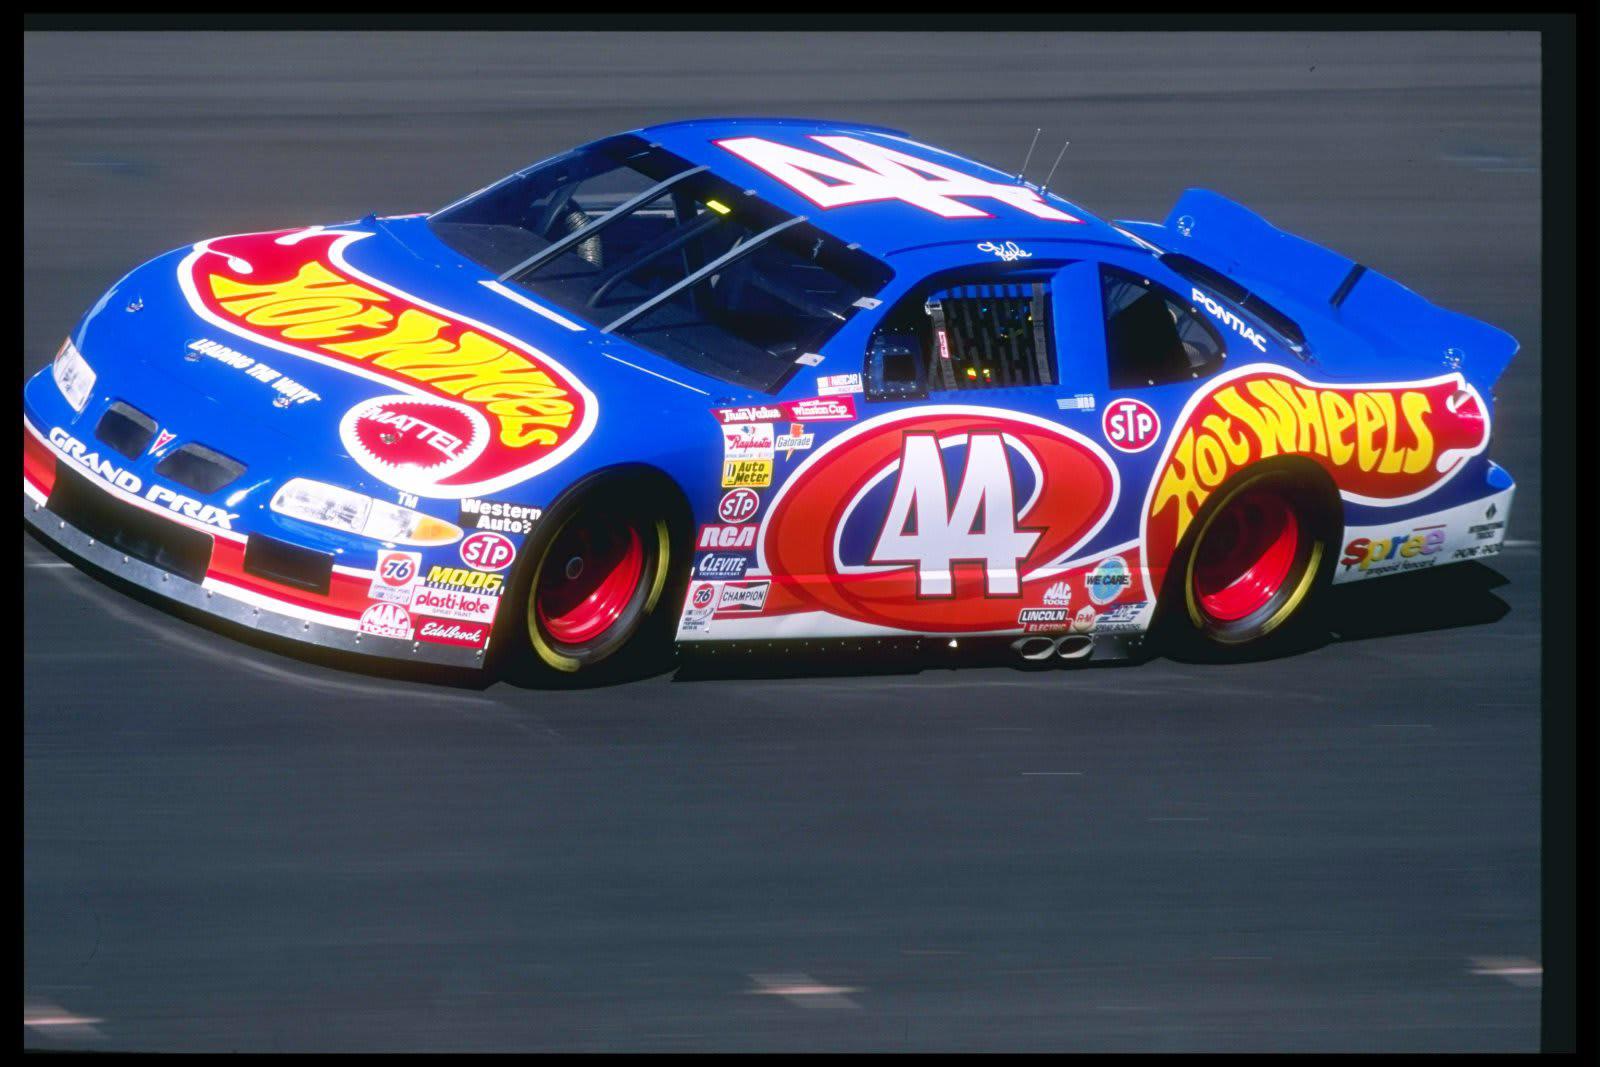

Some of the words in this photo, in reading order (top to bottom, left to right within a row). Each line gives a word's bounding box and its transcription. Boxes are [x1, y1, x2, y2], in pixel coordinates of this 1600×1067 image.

[712, 135, 1087, 224] 44
[1191, 287, 1267, 353] PONTIAC
[245, 363, 282, 383] THE
[746, 406, 782, 422] Value
[828, 404, 848, 417] Cup
[366, 406, 467, 461] MATTEL
[1110, 404, 1153, 443] STP
[777, 436, 811, 448] Gatorade
[738, 462, 765, 473] Auto
[49, 427, 142, 492] GRAND
[145, 484, 241, 531] PRIX
[735, 472, 769, 484] Meter
[398, 491, 419, 509] TM
[460, 498, 542, 520] Western
[722, 491, 754, 517] STP
[476, 515, 523, 533] Auto
[867, 430, 1046, 598] 44
[700, 526, 757, 547] RCA
[465, 536, 509, 565] STP
[1341, 530, 1447, 571] Spree
[384, 560, 410, 580] 76
[427, 566, 505, 590] MOOG
[1044, 582, 1072, 599] MAC
[1086, 576, 1102, 585] WE
[415, 591, 490, 614] plasti-kote
[694, 588, 711, 602] 76
[722, 591, 765, 602] CHAMPION
[362, 604, 410, 629] MAC
[1022, 611, 1066, 621] LINCOLN
[420, 621, 483, 643] Edelbrock
[1029, 623, 1067, 632] ELECTRIC
